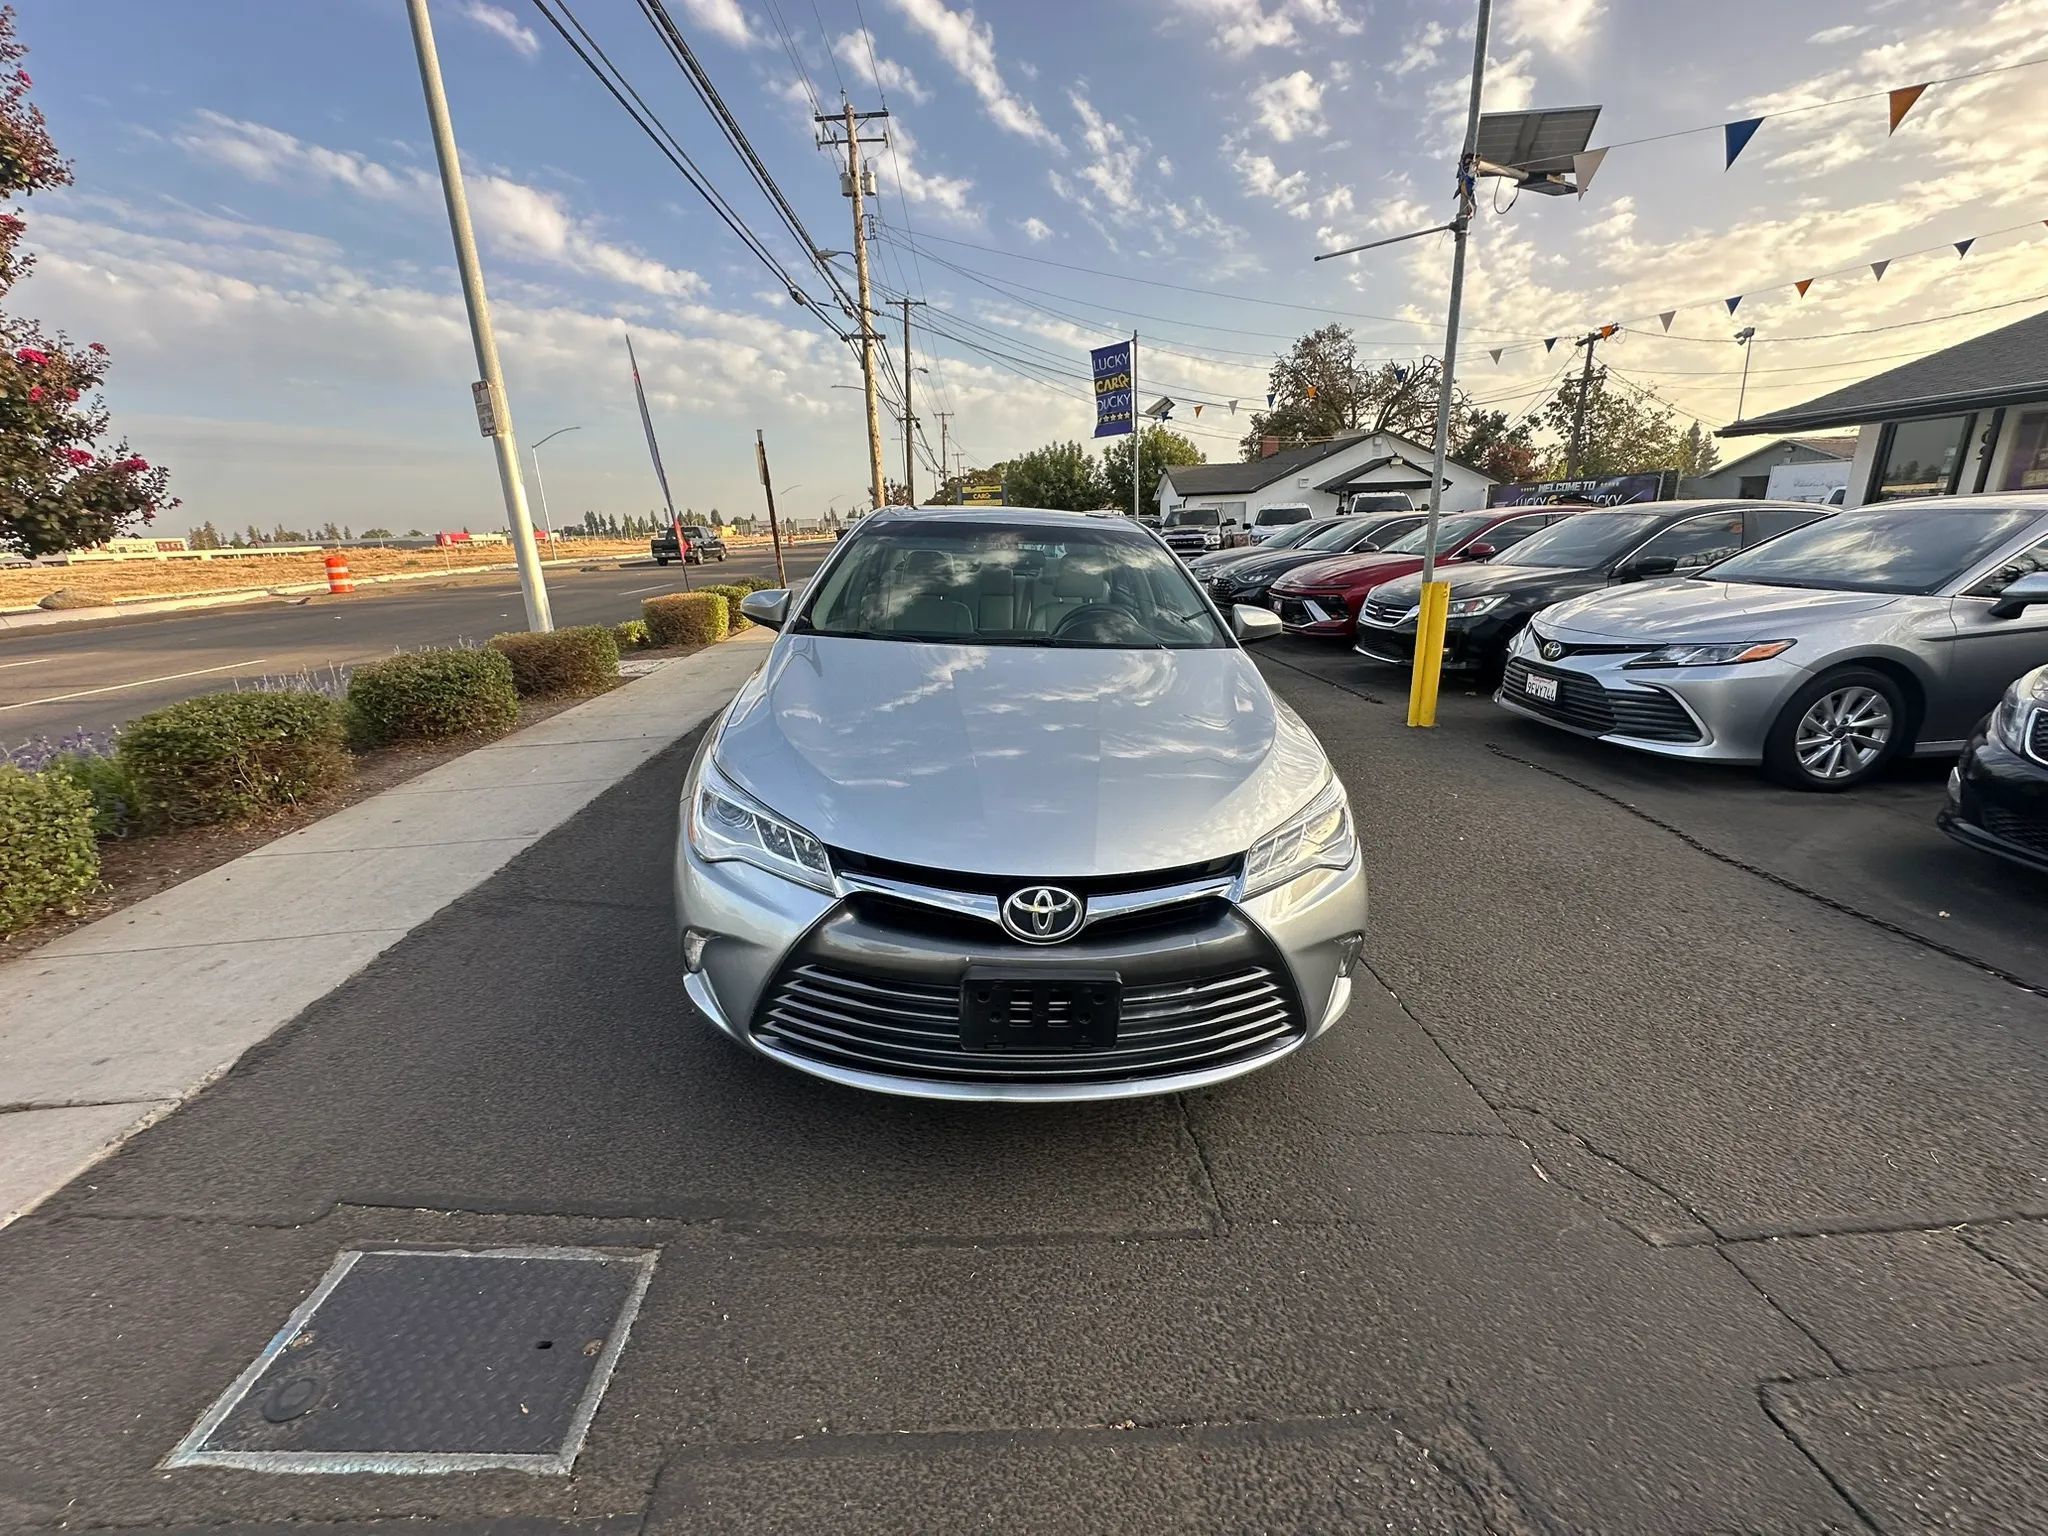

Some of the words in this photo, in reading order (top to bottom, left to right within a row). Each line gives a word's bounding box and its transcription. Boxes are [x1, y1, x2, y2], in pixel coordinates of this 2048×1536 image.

[1093, 351, 1130, 372] LUCKY
[1538, 482, 1581, 493] WELCOME
[1583, 481, 1596, 491] TO
